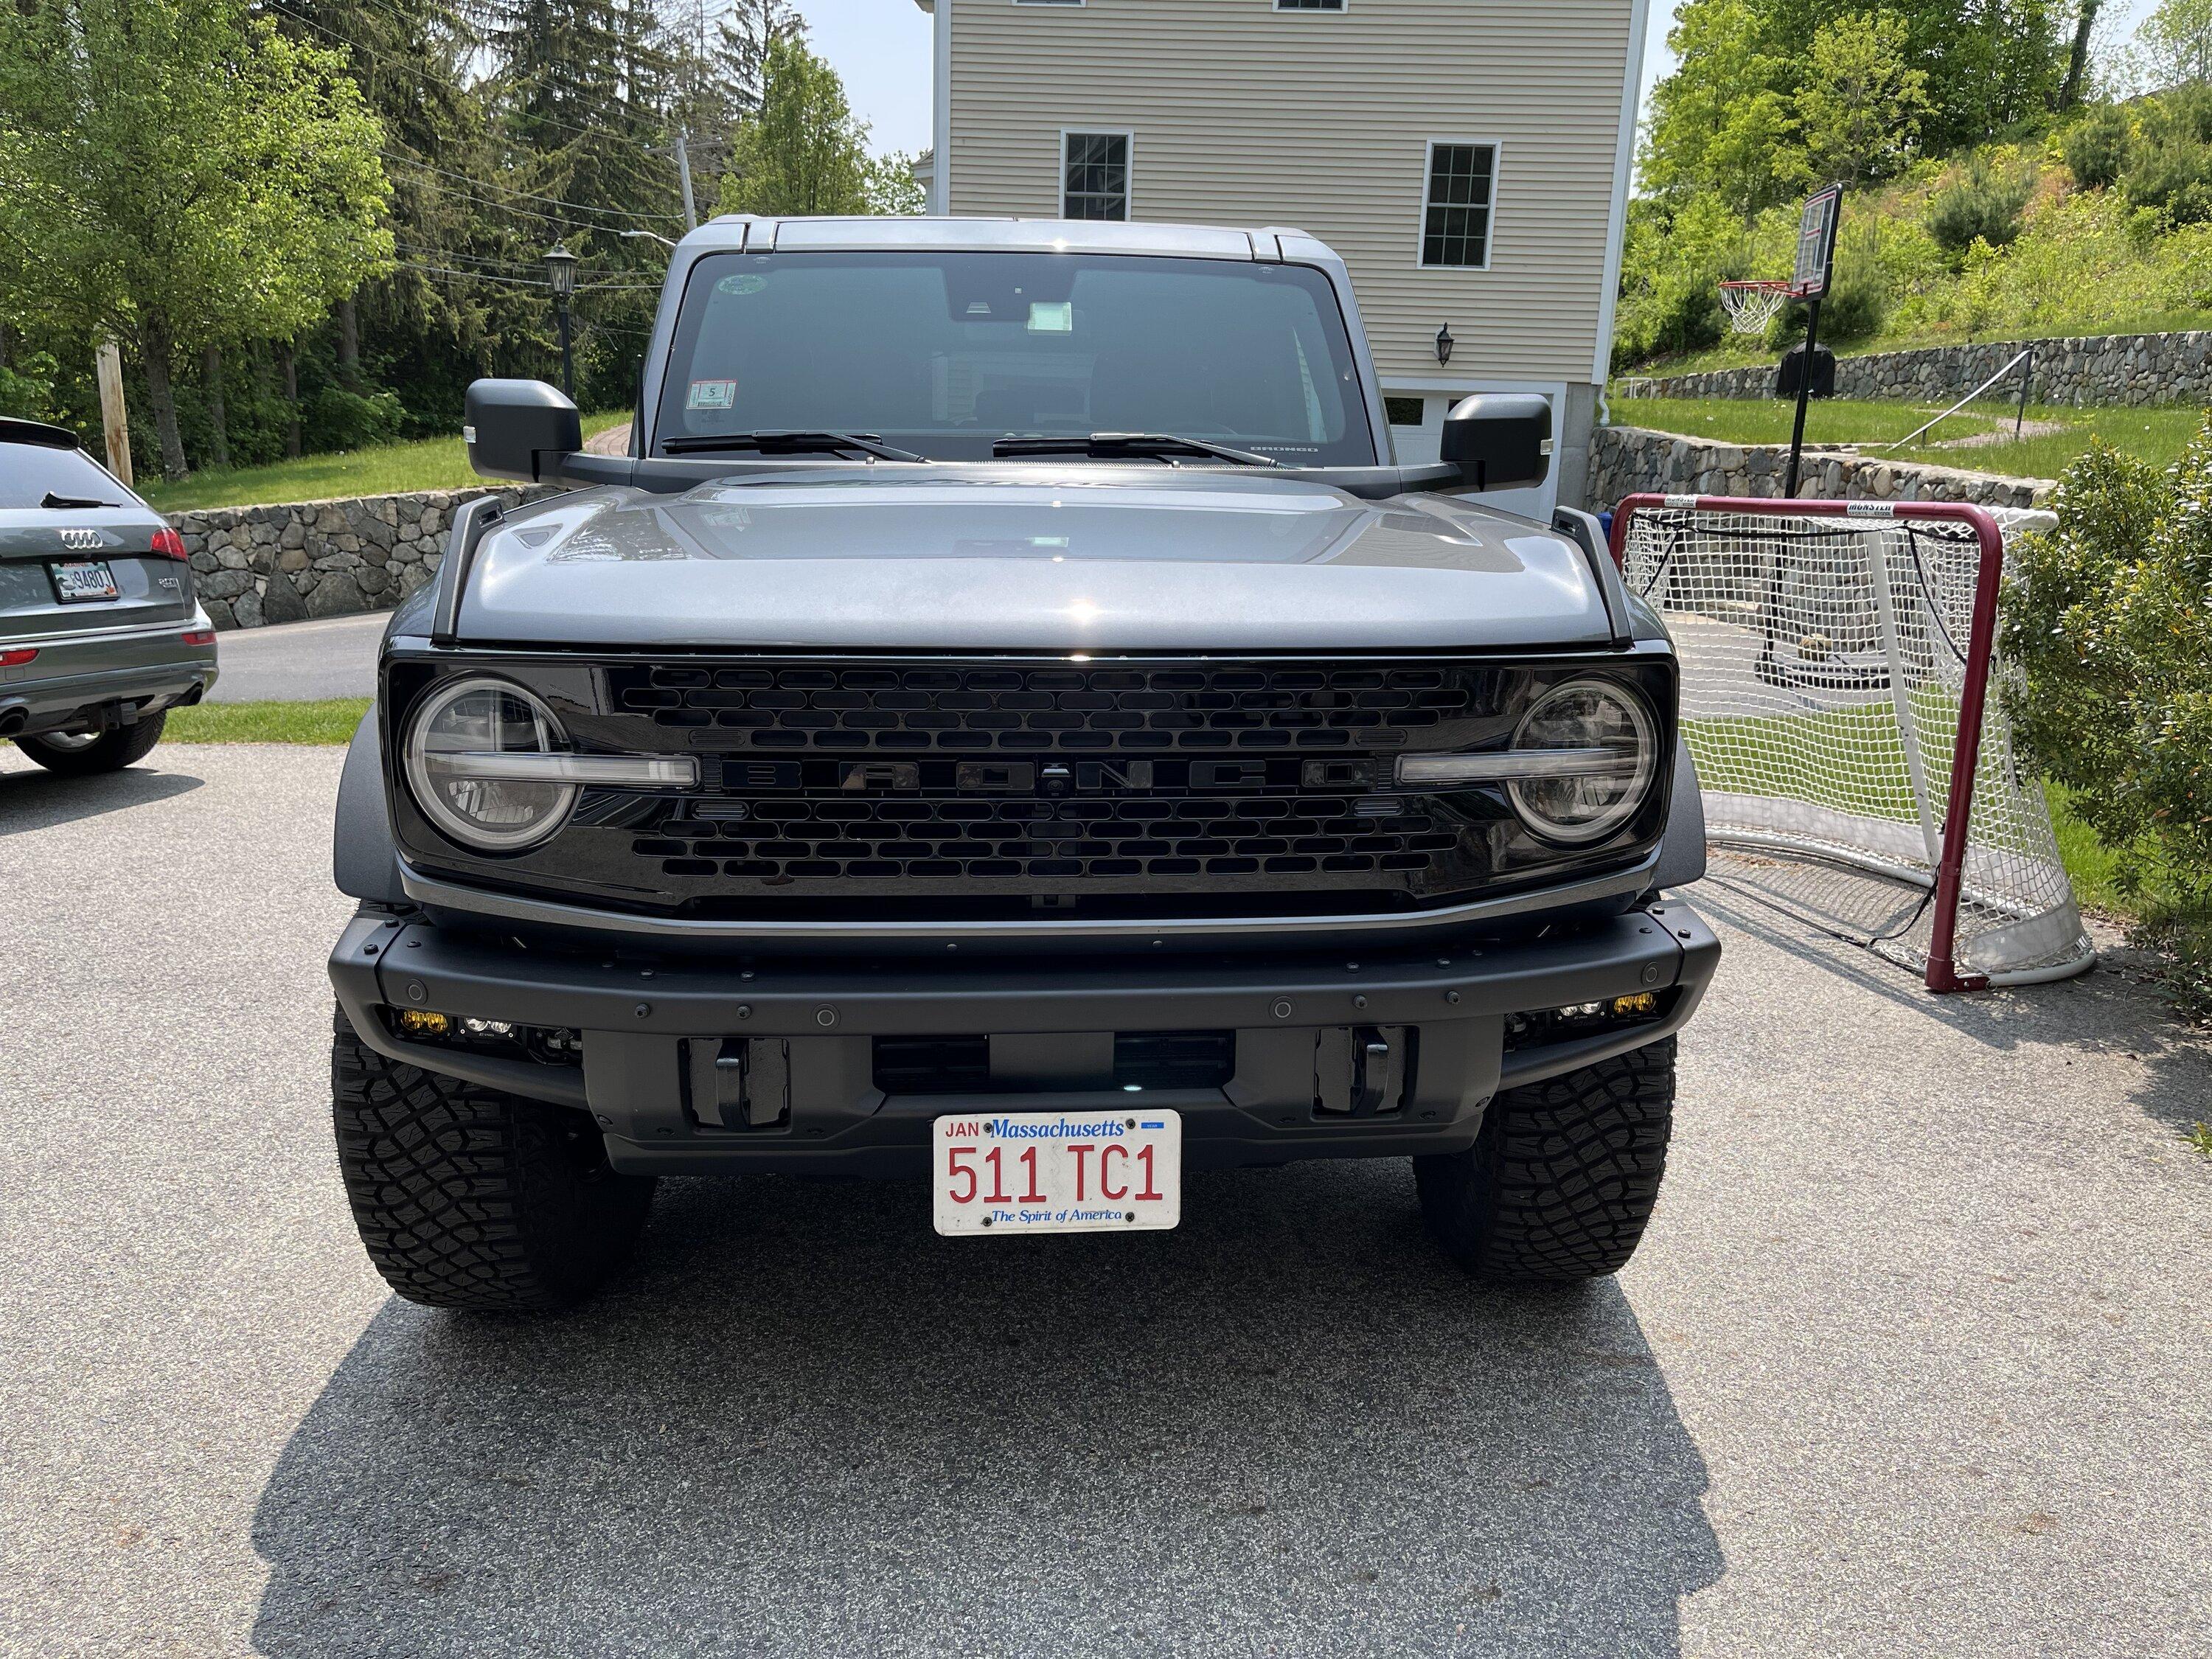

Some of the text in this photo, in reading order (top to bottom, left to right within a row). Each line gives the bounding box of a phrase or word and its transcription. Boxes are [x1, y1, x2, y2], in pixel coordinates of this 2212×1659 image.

[709, 388, 716, 397] 5
[720, 760, 1378, 790] BRONCO
[945, 1121, 979, 1138] JAN
[990, 1118, 1124, 1139] Massachusetts
[948, 1144, 1164, 1203] 511 TC1
[992, 1209, 1121, 1223] The Spirit of America
